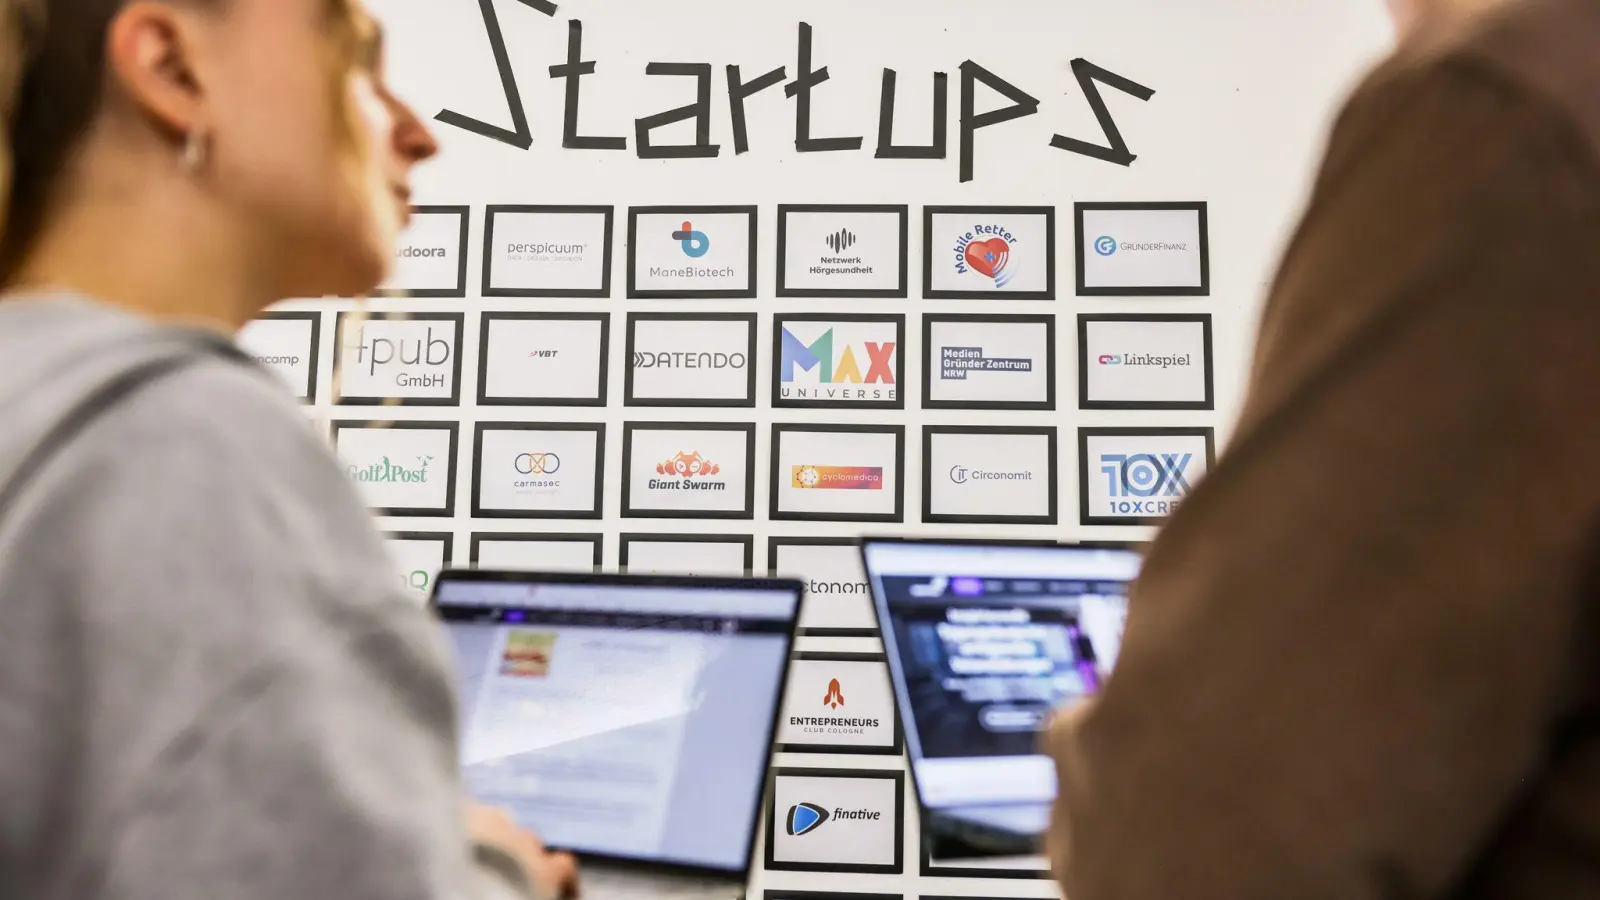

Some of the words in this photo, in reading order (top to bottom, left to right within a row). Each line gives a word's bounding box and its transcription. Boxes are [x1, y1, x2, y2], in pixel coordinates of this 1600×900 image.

[434, 0, 1156, 183] Startups
[954, 232, 974, 274] Mobile
[974, 224, 1017, 244] Retter
[820, 256, 861, 264] Netzwerk
[650, 266, 734, 278] ManeBiotech
[809, 266, 873, 275] Hörgesundheit
[538, 350, 558, 358] VBT
[943, 349, 981, 359] Medien
[943, 359, 986, 370] Gründer
[986, 360, 1031, 370] Zentrum
[1123, 354, 1191, 368] Linkspiel
[395, 373, 445, 388] GmbH
[943, 370, 966, 379] NRW
[781, 388, 896, 400] UNIVERSE
[391, 465, 428, 483] Post
[972, 470, 1032, 480] Circonomit
[648, 479, 681, 490] Giant
[683, 480, 725, 491] Swarm
[790, 717, 879, 727] ENTREPRENEURS
[832, 808, 881, 822] finative
